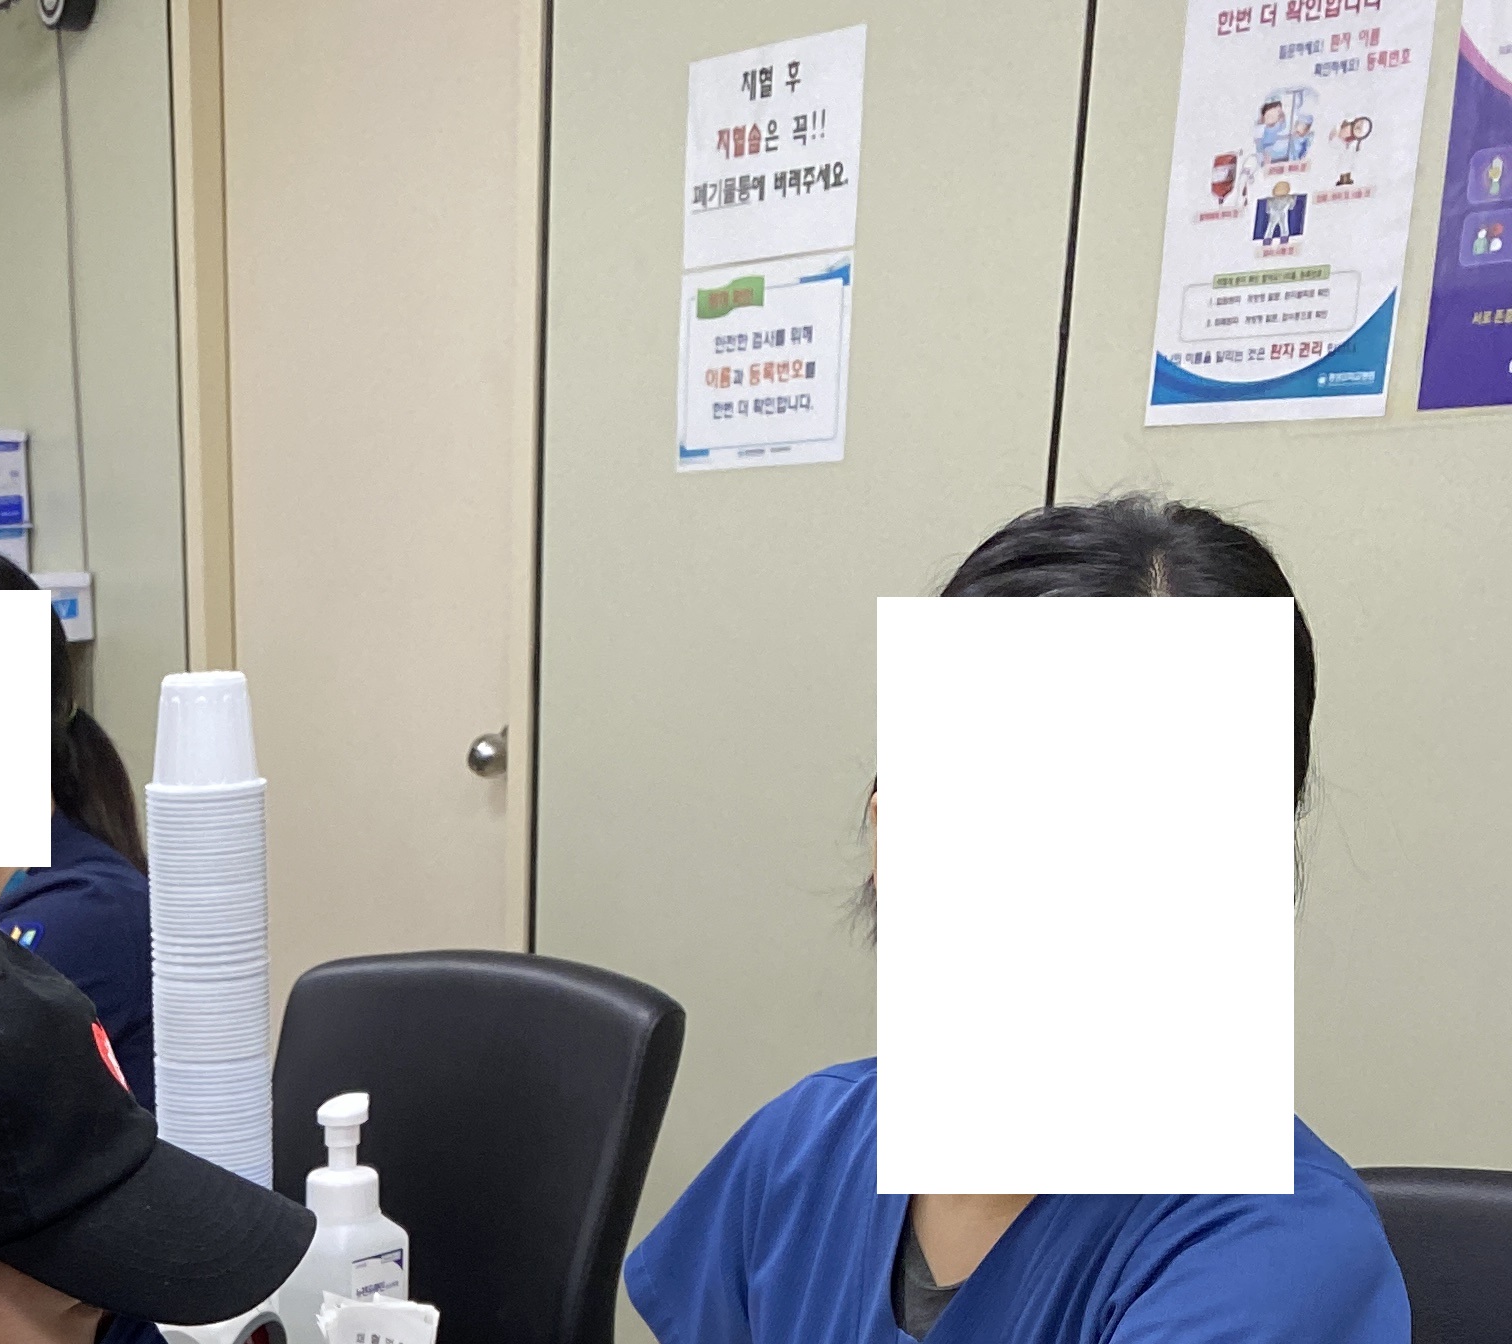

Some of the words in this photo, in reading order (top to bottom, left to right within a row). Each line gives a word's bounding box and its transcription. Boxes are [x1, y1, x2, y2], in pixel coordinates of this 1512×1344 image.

[1217, 7, 1252, 36] 한번
[1260, 3, 1278, 27] 더
[741, 65, 773, 101] 채혈
[785, 60, 801, 93] 후
[793, 108, 826, 147] 꼭!!
[693, 173, 766, 207] 폐기물통에
[774, 161, 849, 198] 버려주세요.
[1299, 341, 1324, 358] 권리
